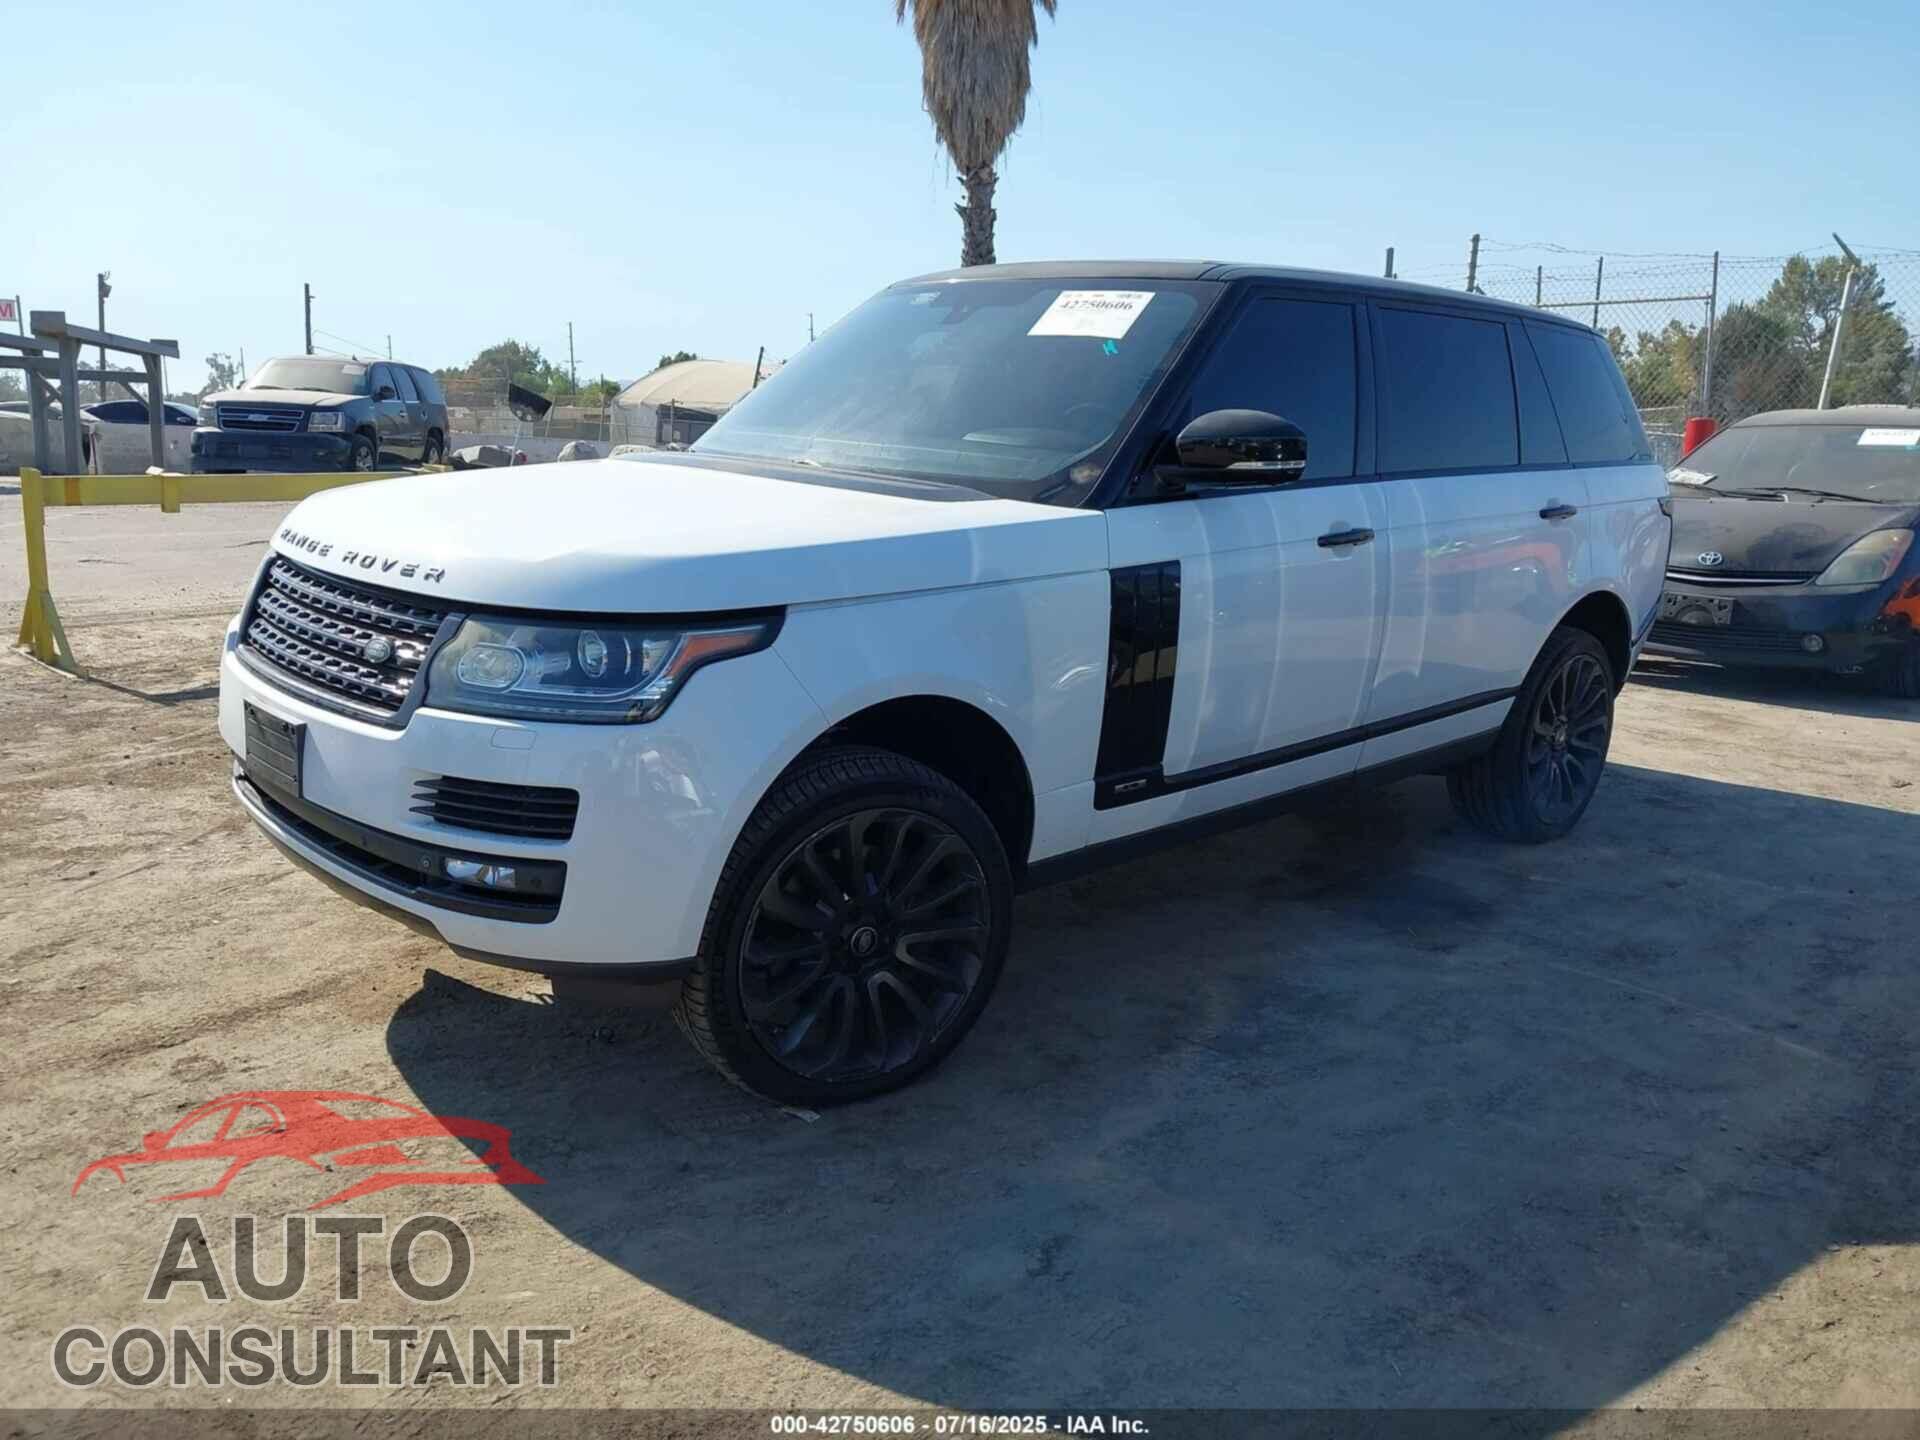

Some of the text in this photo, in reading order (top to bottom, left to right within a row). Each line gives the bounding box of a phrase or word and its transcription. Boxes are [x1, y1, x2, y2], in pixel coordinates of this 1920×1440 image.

[1060, 300, 1134, 310] 42750606
[280, 528, 446, 583] RANGE ROVER
